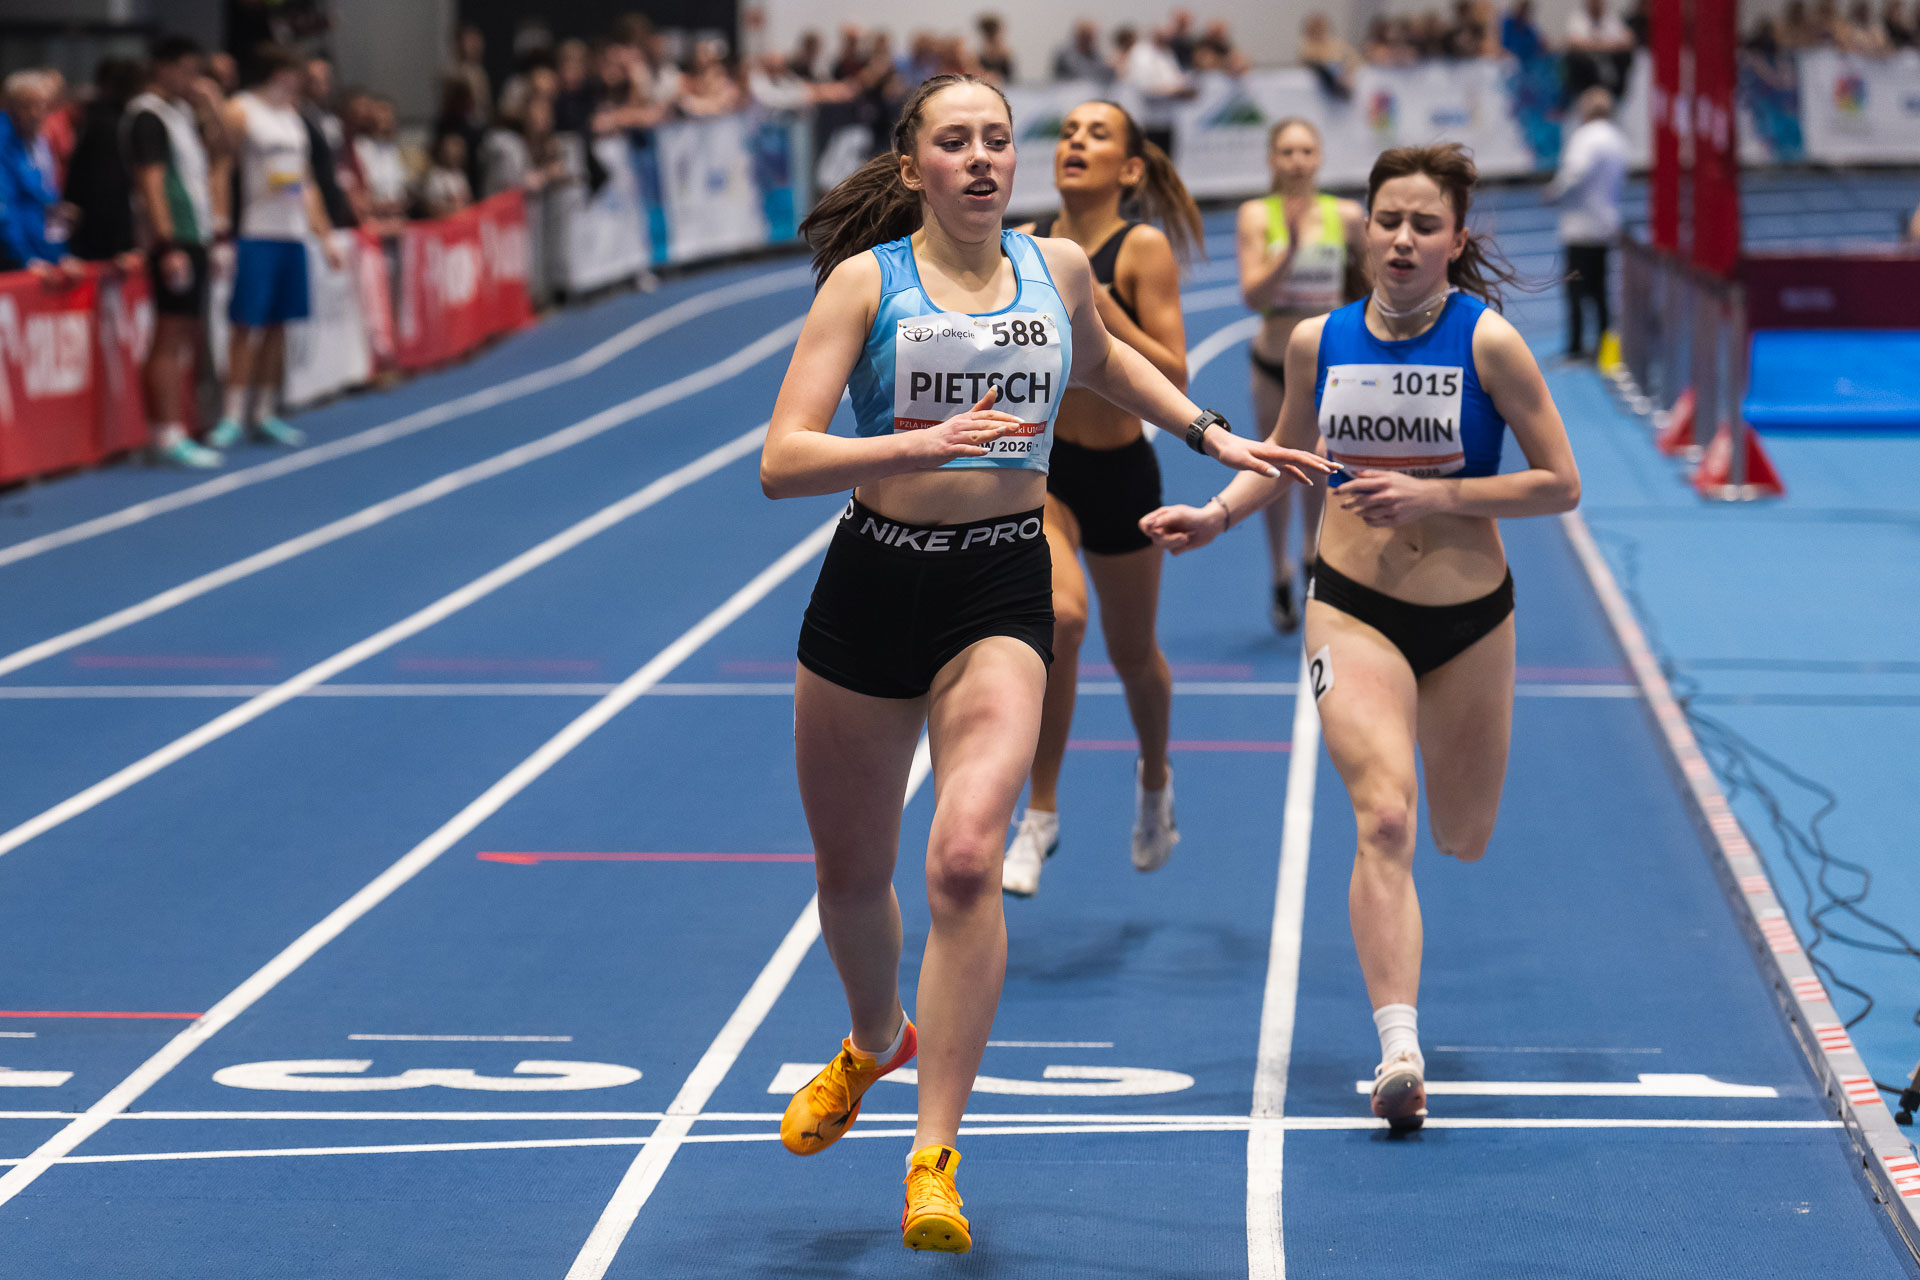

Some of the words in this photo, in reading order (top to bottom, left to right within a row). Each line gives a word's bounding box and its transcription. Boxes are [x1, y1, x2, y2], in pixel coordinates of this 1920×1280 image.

[942, 328, 975, 340] Okęcie
[992, 320, 1048, 347] 588
[910, 372, 1051, 404] PIETSCH
[1392, 372, 1457, 396] 1015
[899, 420, 919, 429] PZLA
[1327, 414, 1454, 443] JAROMIN
[999, 441, 1032, 453] 2026
[860, 517, 956, 551] NIKE
[961, 517, 1041, 550] PRO
[1310, 658, 1327, 701] 2
